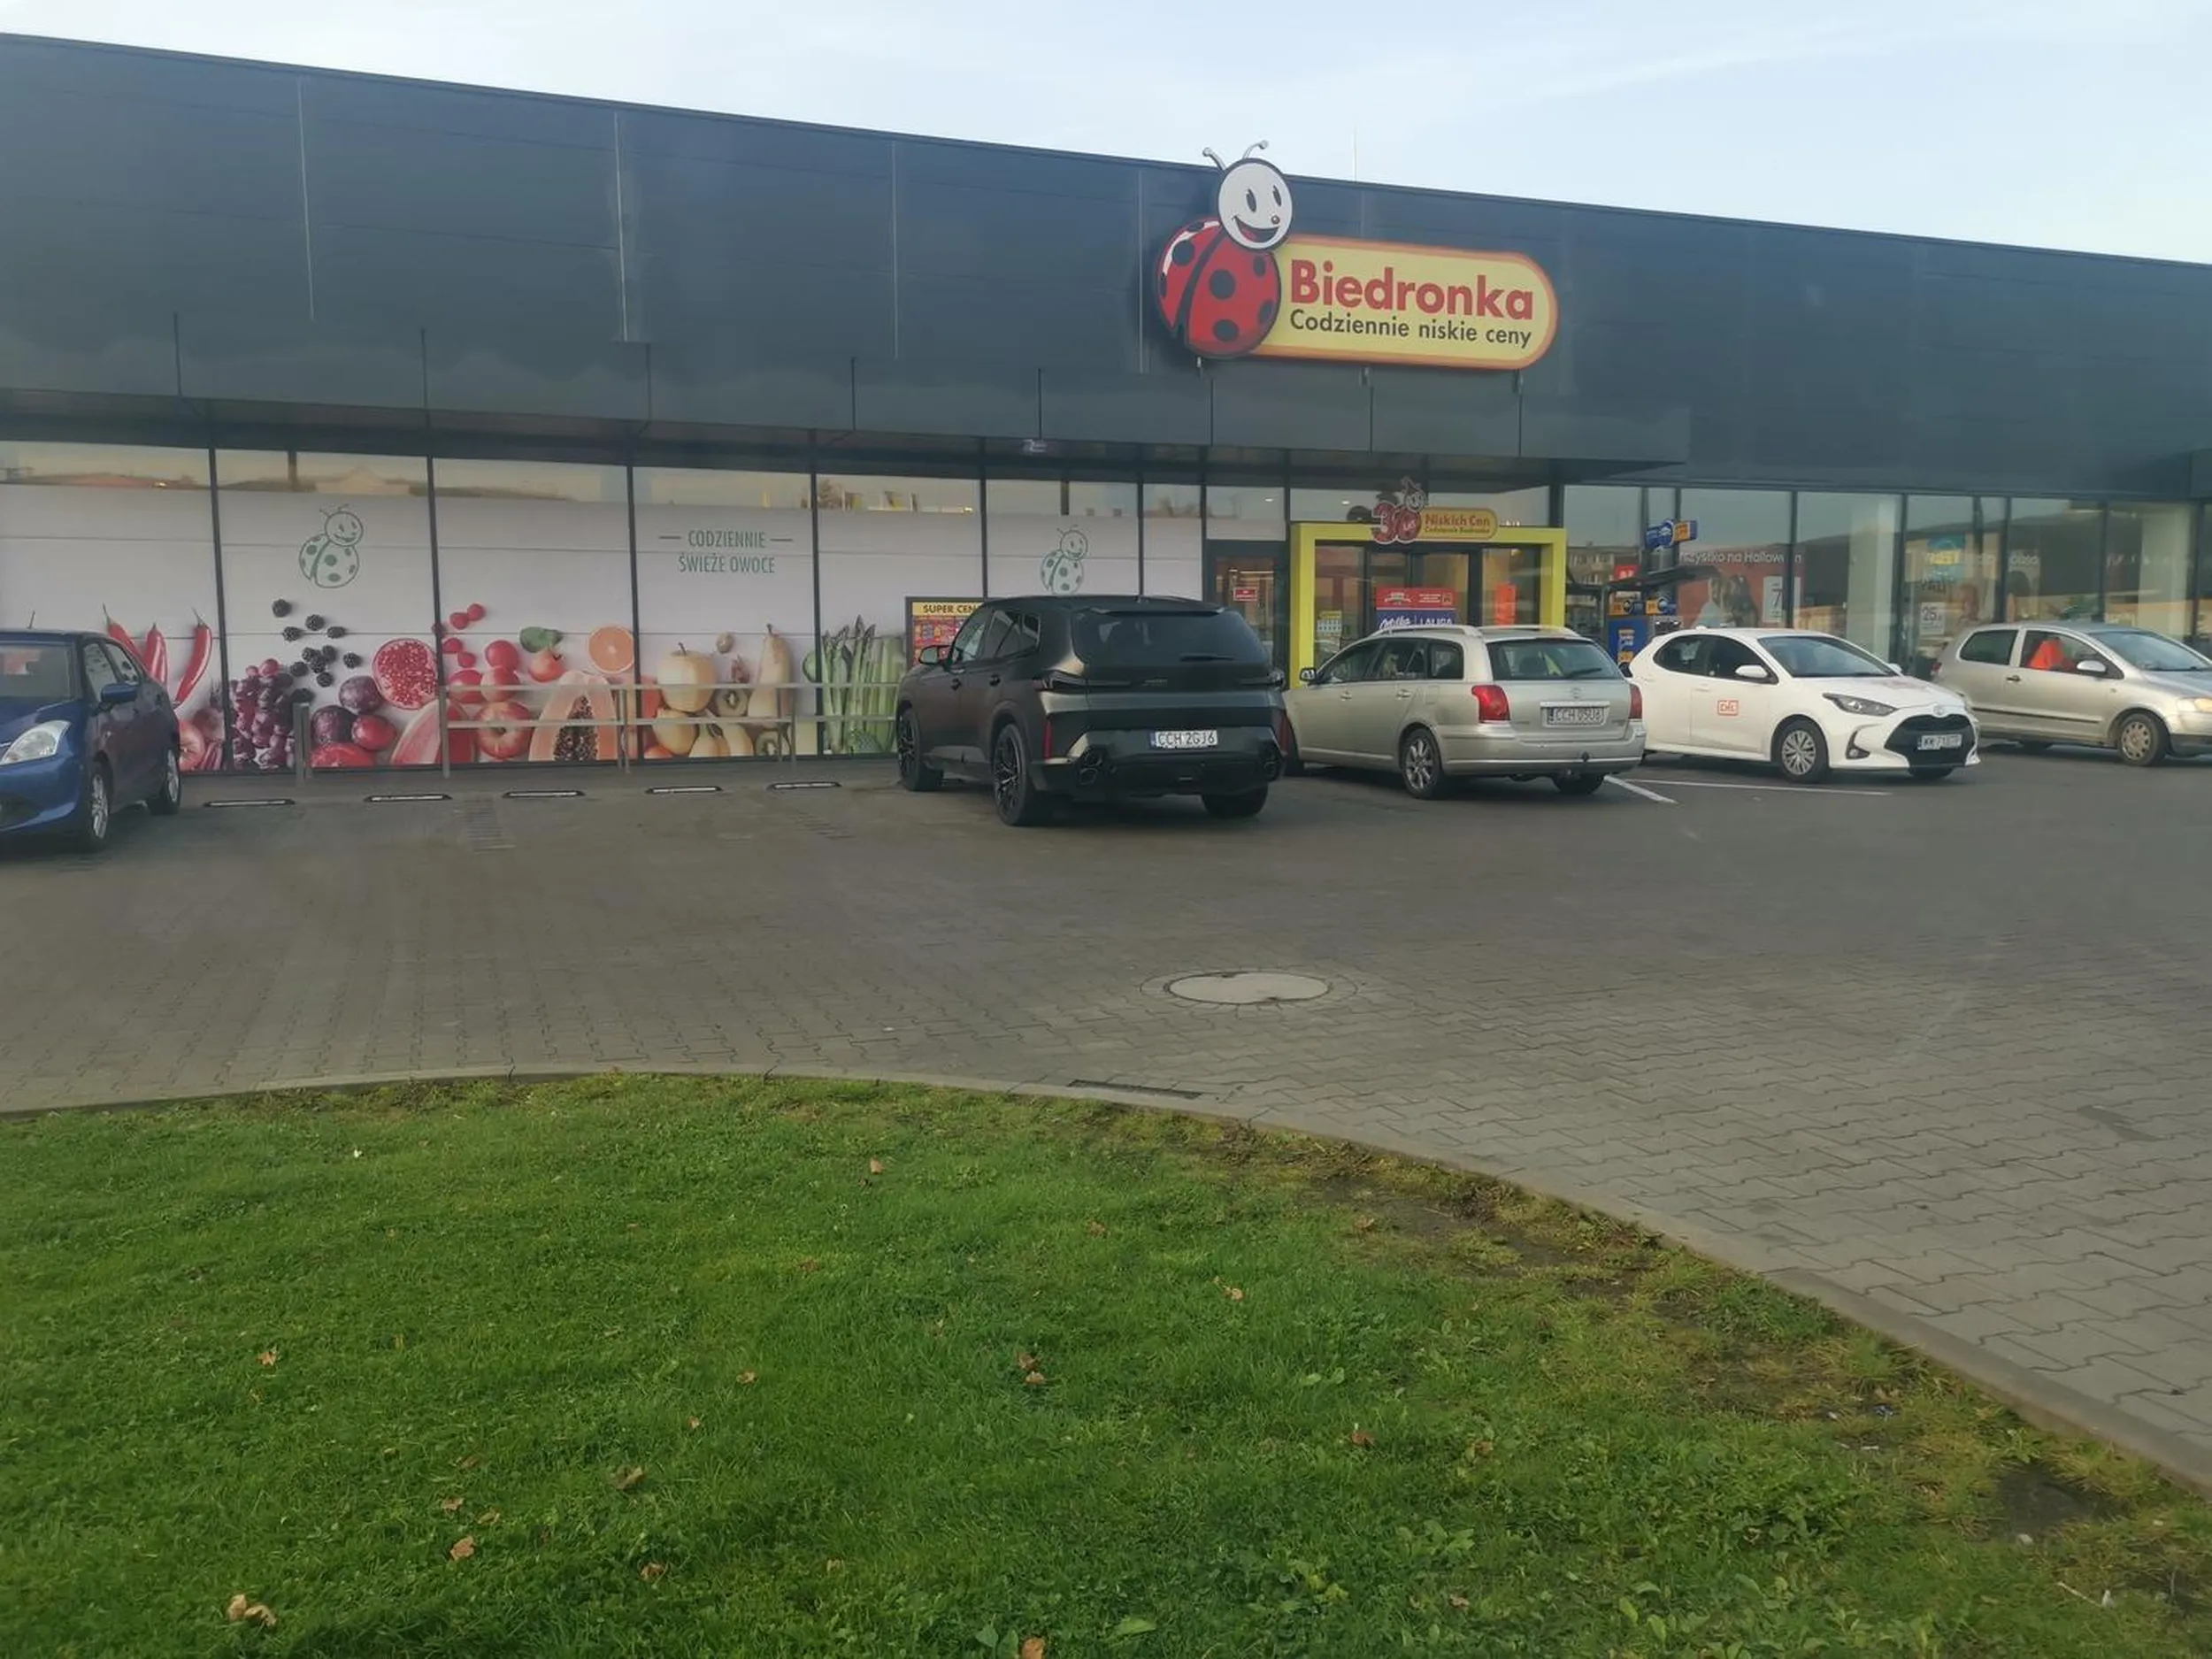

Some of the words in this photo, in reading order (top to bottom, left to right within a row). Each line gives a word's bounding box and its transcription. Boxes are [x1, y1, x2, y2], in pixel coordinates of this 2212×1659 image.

[1291, 259, 1532, 320] Biedronka
[1290, 309, 1409, 338] Codziennie
[1418, 319, 1478, 342] niskie
[1486, 327, 1532, 349] ceny
[1425, 513, 1468, 526] Niskich
[687, 530, 767, 549] CODZIENNIE
[678, 551, 726, 573] ŚWIEŻE
[729, 556, 775, 573] OWOCE
[923, 604, 954, 614] SUPER
[956, 604, 977, 614] CEN
[1158, 733, 1182, 746] CCH
